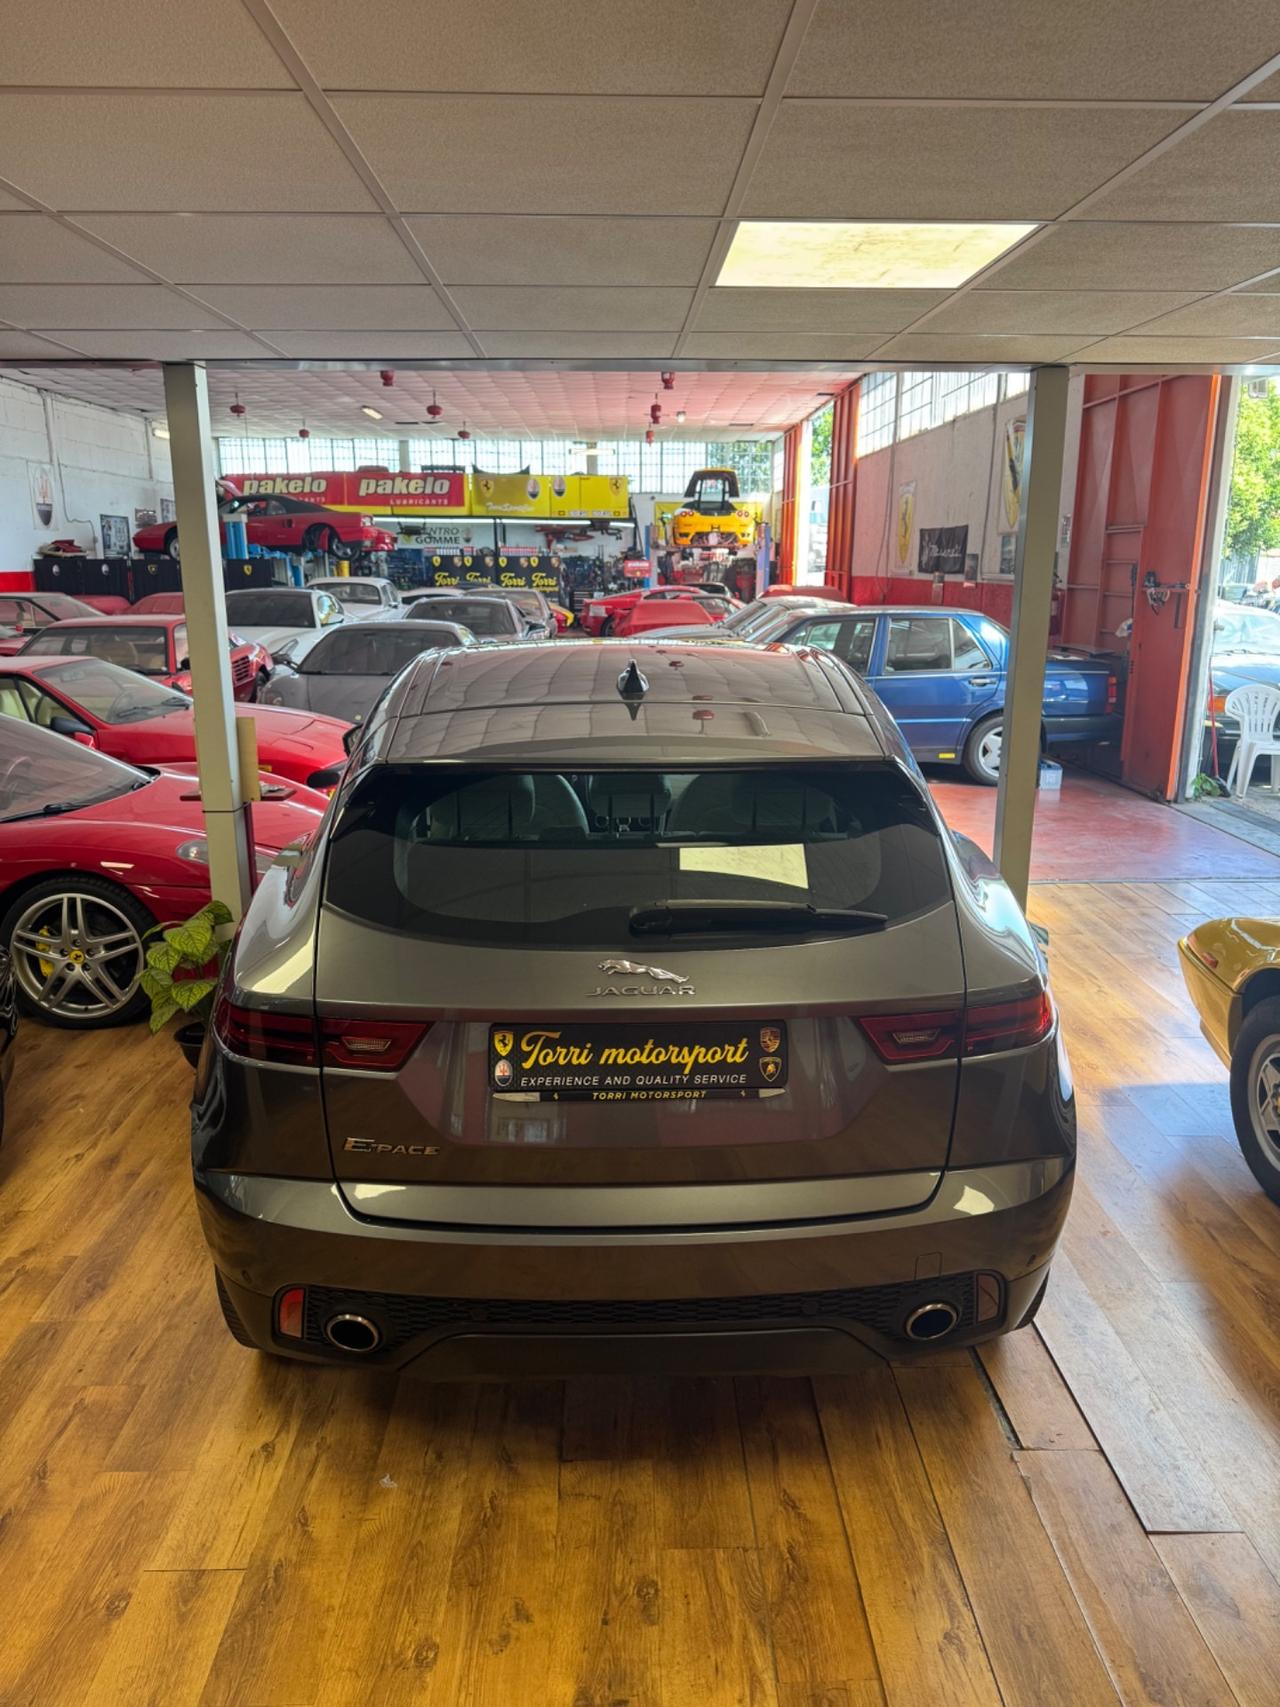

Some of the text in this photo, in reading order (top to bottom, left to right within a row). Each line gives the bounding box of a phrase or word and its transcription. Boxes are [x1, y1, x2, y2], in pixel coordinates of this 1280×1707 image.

[242, 476, 328, 496] pakelo
[358, 475, 451, 497] pakelo
[389, 498, 449, 506] LUBRICANTS
[415, 536, 461, 545] GOMME
[434, 571, 460, 587] Torri
[500, 572, 526, 587] Torri
[531, 572, 557, 587] Torri
[583, 984, 697, 997] JAGUAR
[520, 1030, 750, 1075] Torri motorsport
[520, 1073, 748, 1087] EXPERIENCE AND QUALITY SERVICE
[592, 1090, 707, 1101] TORRI MOTORSPORT
